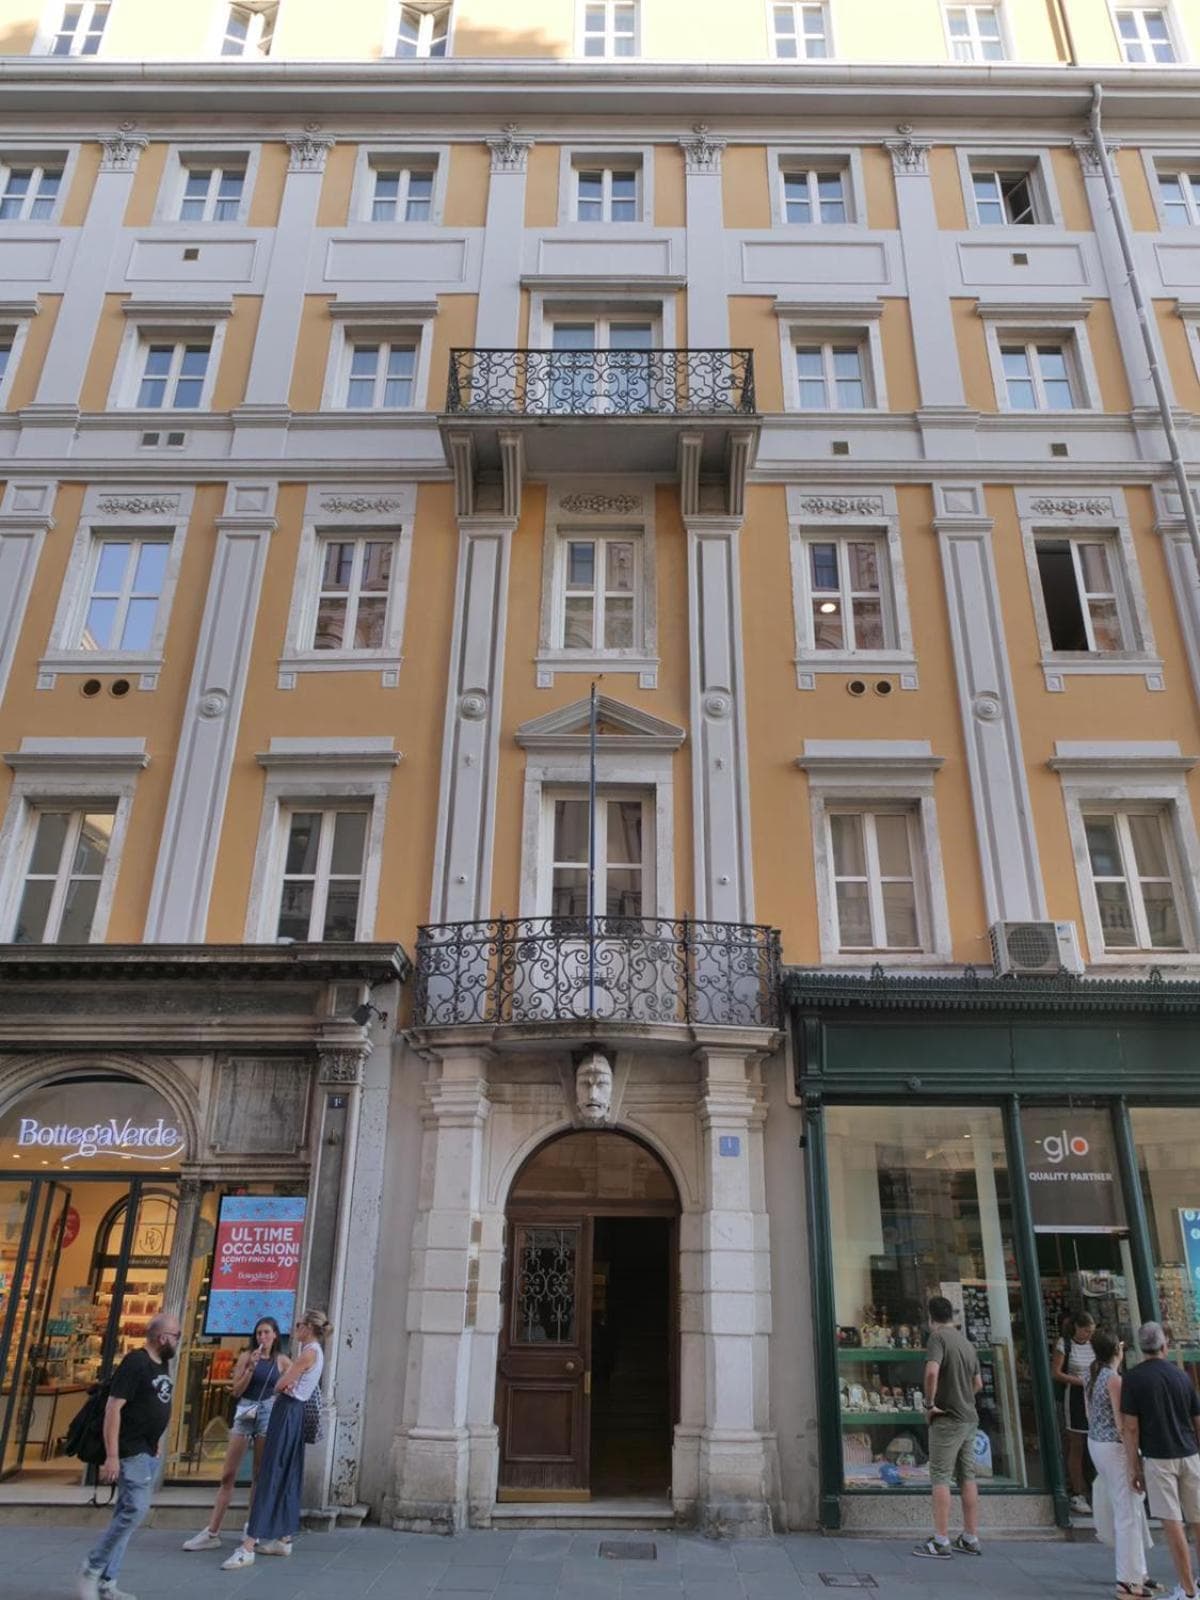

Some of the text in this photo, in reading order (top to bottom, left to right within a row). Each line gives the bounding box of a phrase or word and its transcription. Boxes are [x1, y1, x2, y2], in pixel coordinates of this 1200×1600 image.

[17, 1117, 178, 1157] BottegaVerde
[1043, 1129, 1089, 1164] glo
[1029, 1172, 1113, 1182] QUALITY PARTNER
[231, 1227, 294, 1241] ULTIME
[222, 1242, 300, 1255] OCCASIONI
